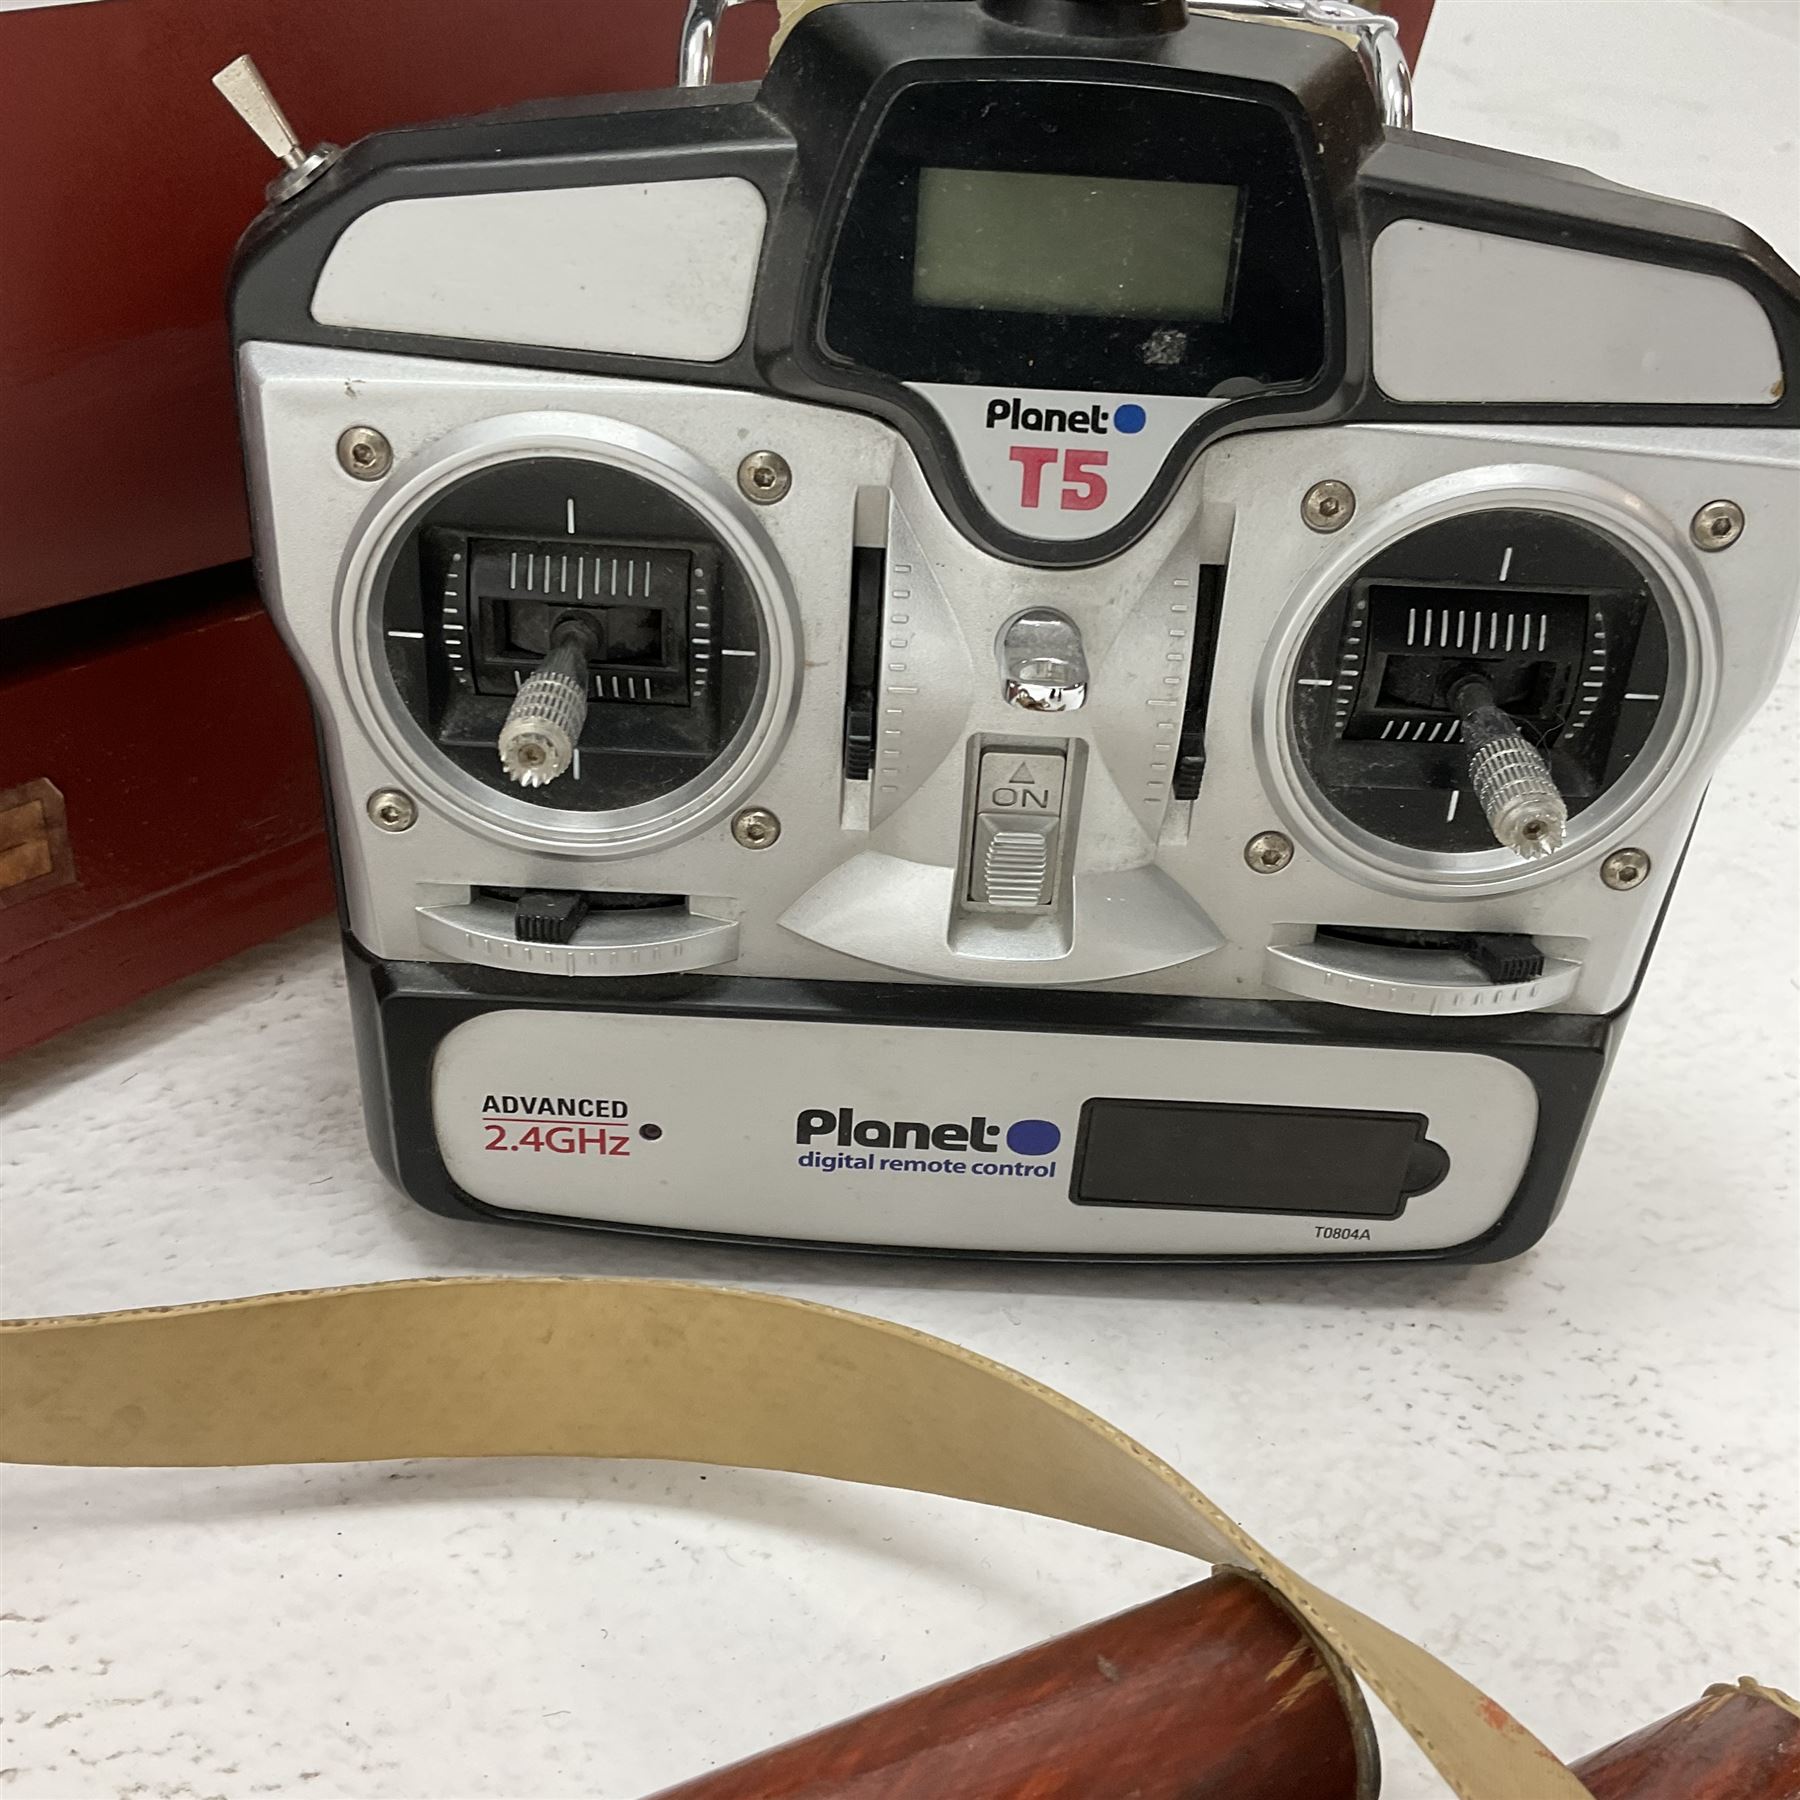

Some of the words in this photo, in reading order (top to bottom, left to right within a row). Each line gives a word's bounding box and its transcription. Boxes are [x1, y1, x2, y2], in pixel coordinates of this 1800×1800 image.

[986, 398, 1109, 434] Planet
[1009, 446, 1108, 511] T5
[992, 787, 1049, 808] ON
[482, 1095, 628, 1118] ADVANCED
[484, 1124, 630, 1156] 2.4GHz
[796, 1107, 1000, 1153] Planet
[798, 1151, 874, 1172] digital
[880, 1157, 967, 1174] remote
[971, 1161, 1056, 1177] control
[1315, 1226, 1371, 1240] T0804A
